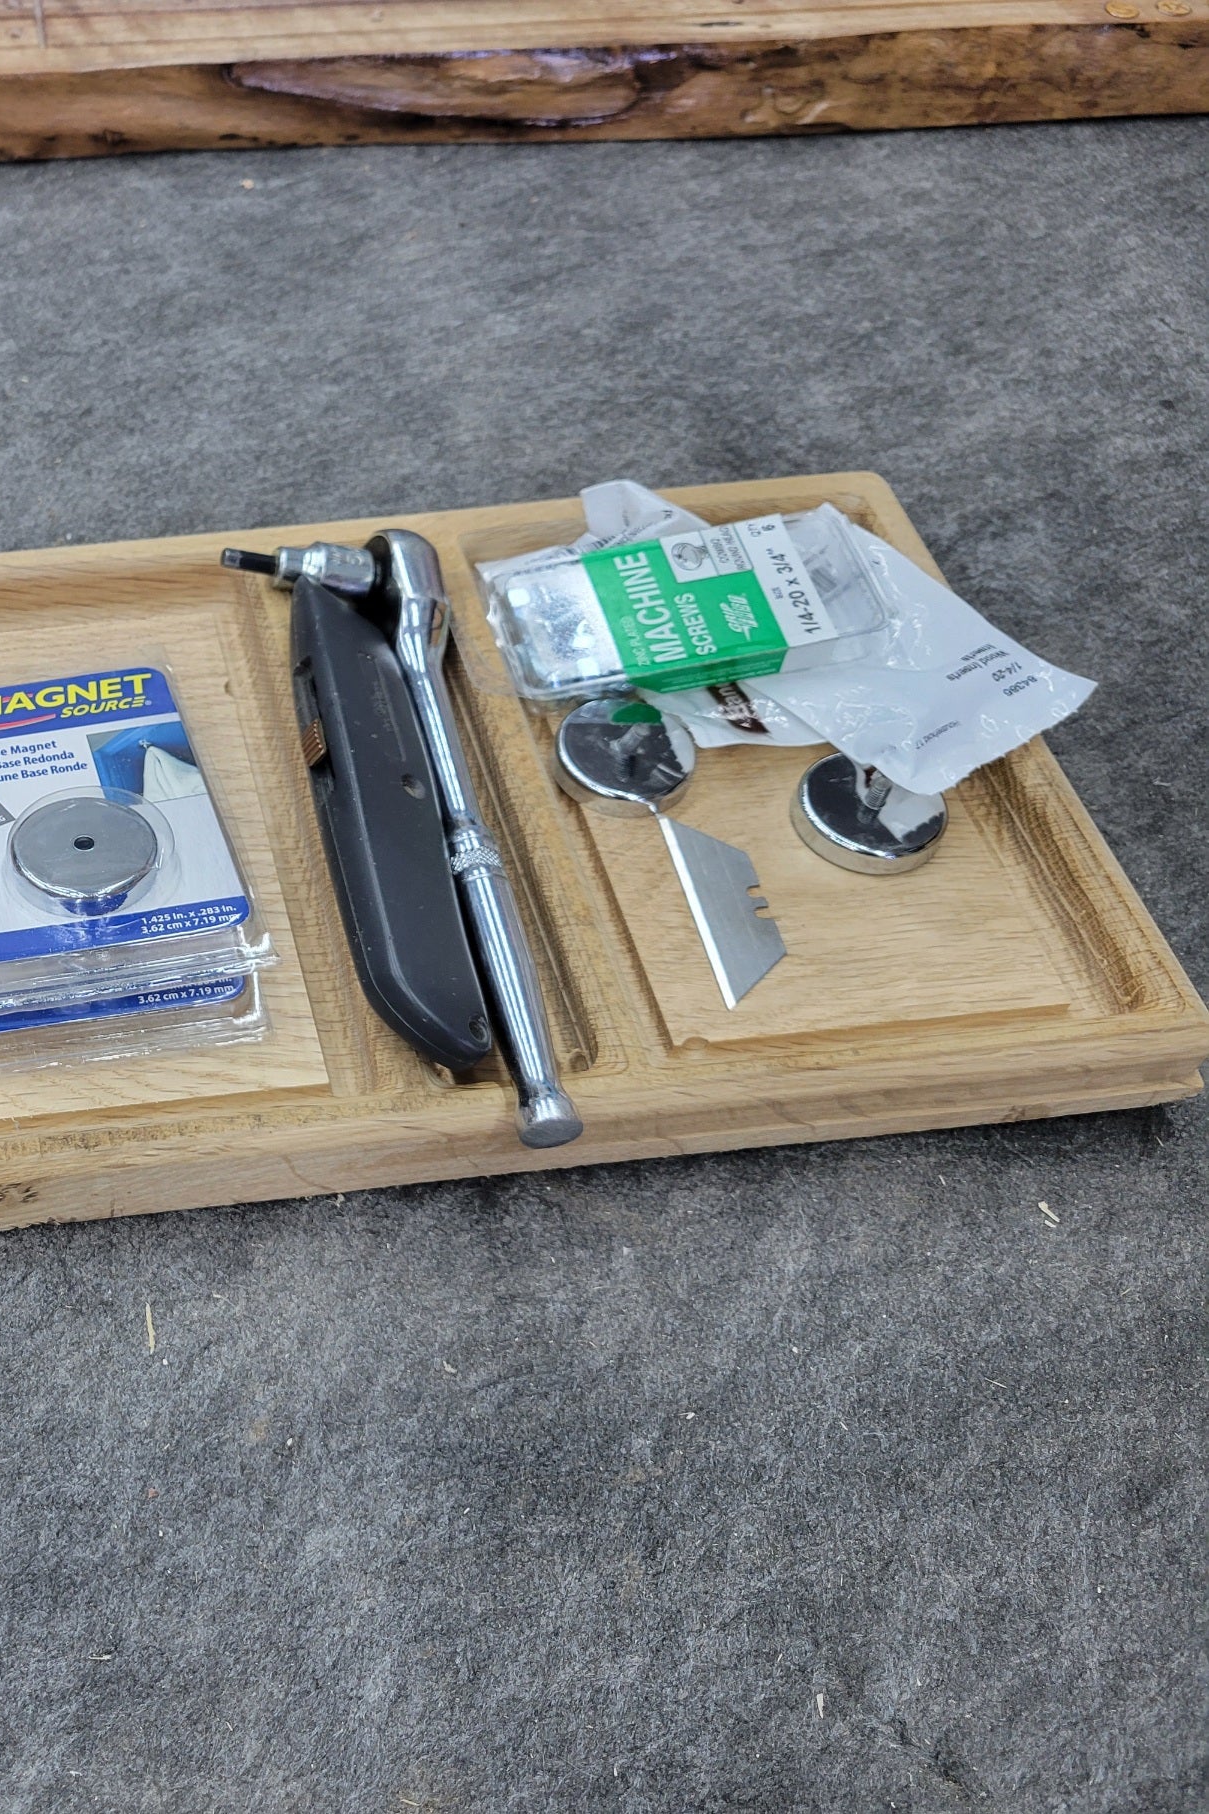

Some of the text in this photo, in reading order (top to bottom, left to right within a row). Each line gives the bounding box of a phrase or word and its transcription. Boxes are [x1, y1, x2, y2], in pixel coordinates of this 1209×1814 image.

[613, 552, 688, 664] MACHINE
[789, 590, 822, 634] 1/4-20
[674, 592, 718, 656] SCREWS
[60, 696, 147, 719] SOURCE
[10, 740, 57, 755] Magnet
[23, 751, 75, 765] Redonda
[21, 767, 49, 779] Base
[51, 762, 88, 775] Ronde
[141, 914, 171, 925] 1.425
[198, 906, 220, 917] .283
[141, 924, 165, 934] 3.62
[167, 922, 183, 930] cm
[192, 914, 216, 925] 7.19
[137, 994, 162, 1004] 3.62
[163, 992, 179, 1000] cm
[189, 986, 212, 996] 7.19
[214, 984, 234, 993] mm
